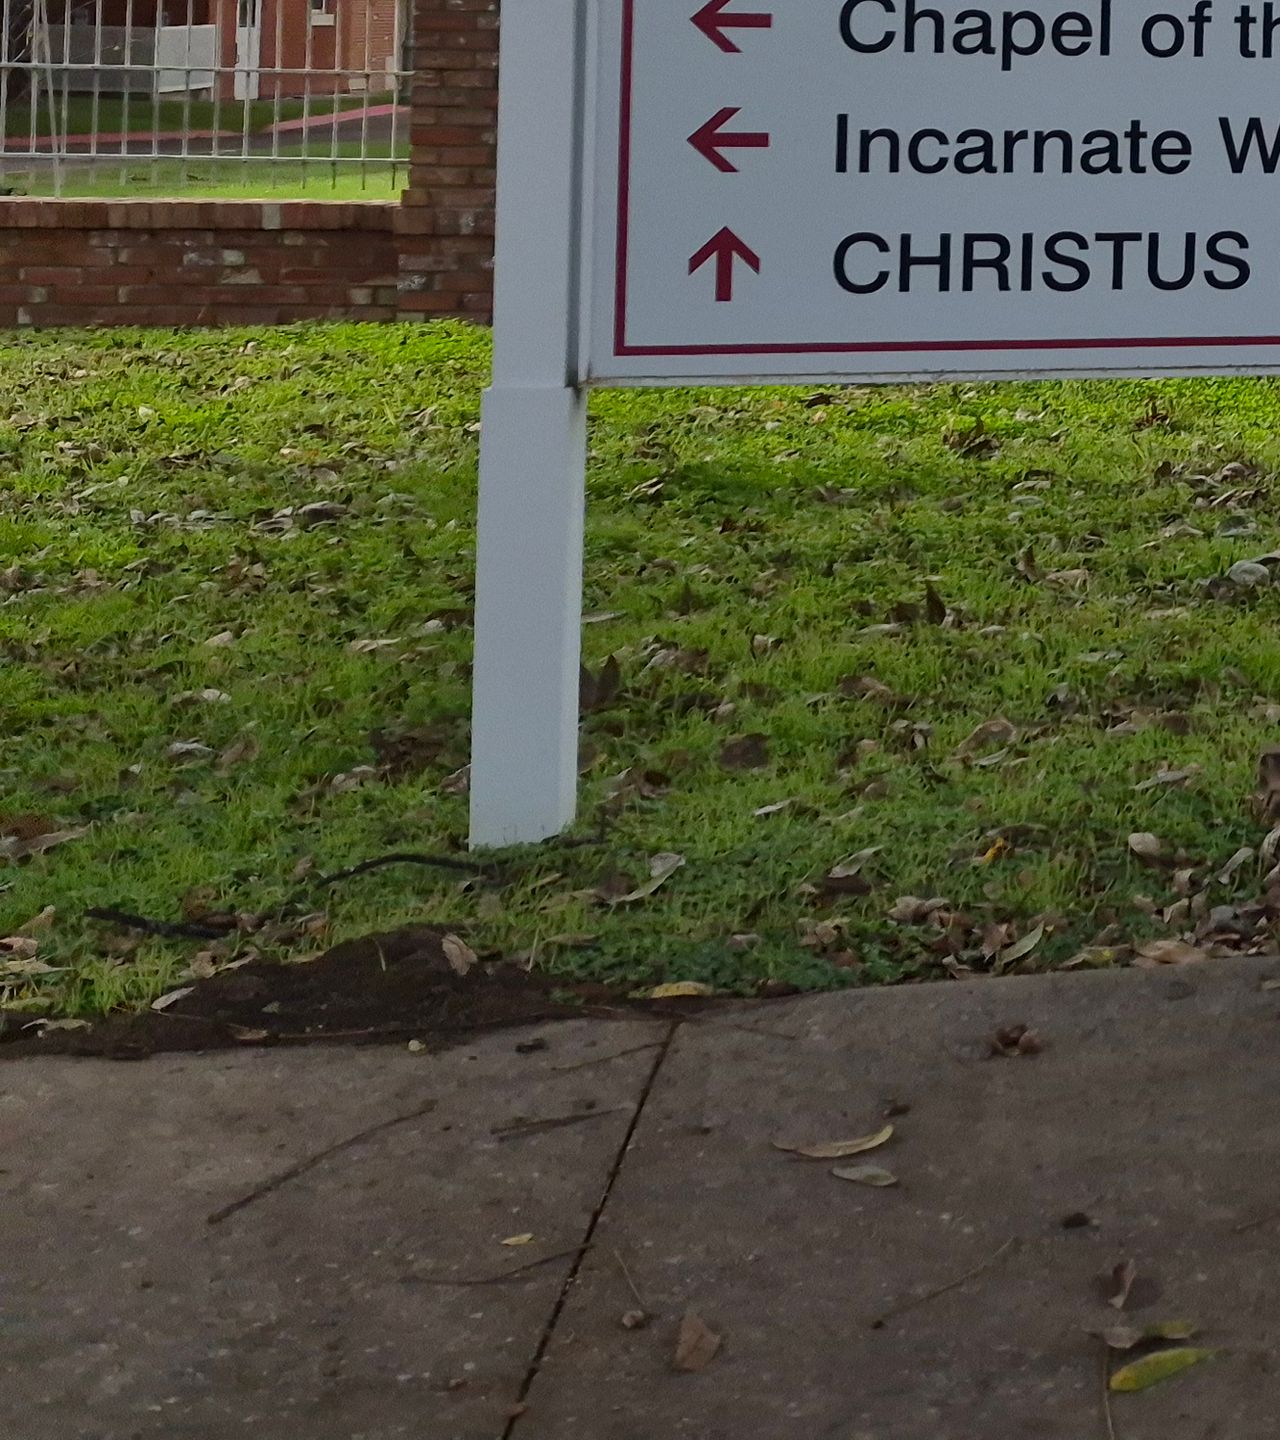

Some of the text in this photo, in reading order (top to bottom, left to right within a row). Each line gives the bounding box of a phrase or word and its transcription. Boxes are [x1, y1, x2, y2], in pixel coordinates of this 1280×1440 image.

[1141, 0, 1213, 59] of
[835, 113, 1192, 175] Incarnate
[832, 230, 1251, 295] CHRISTUS
